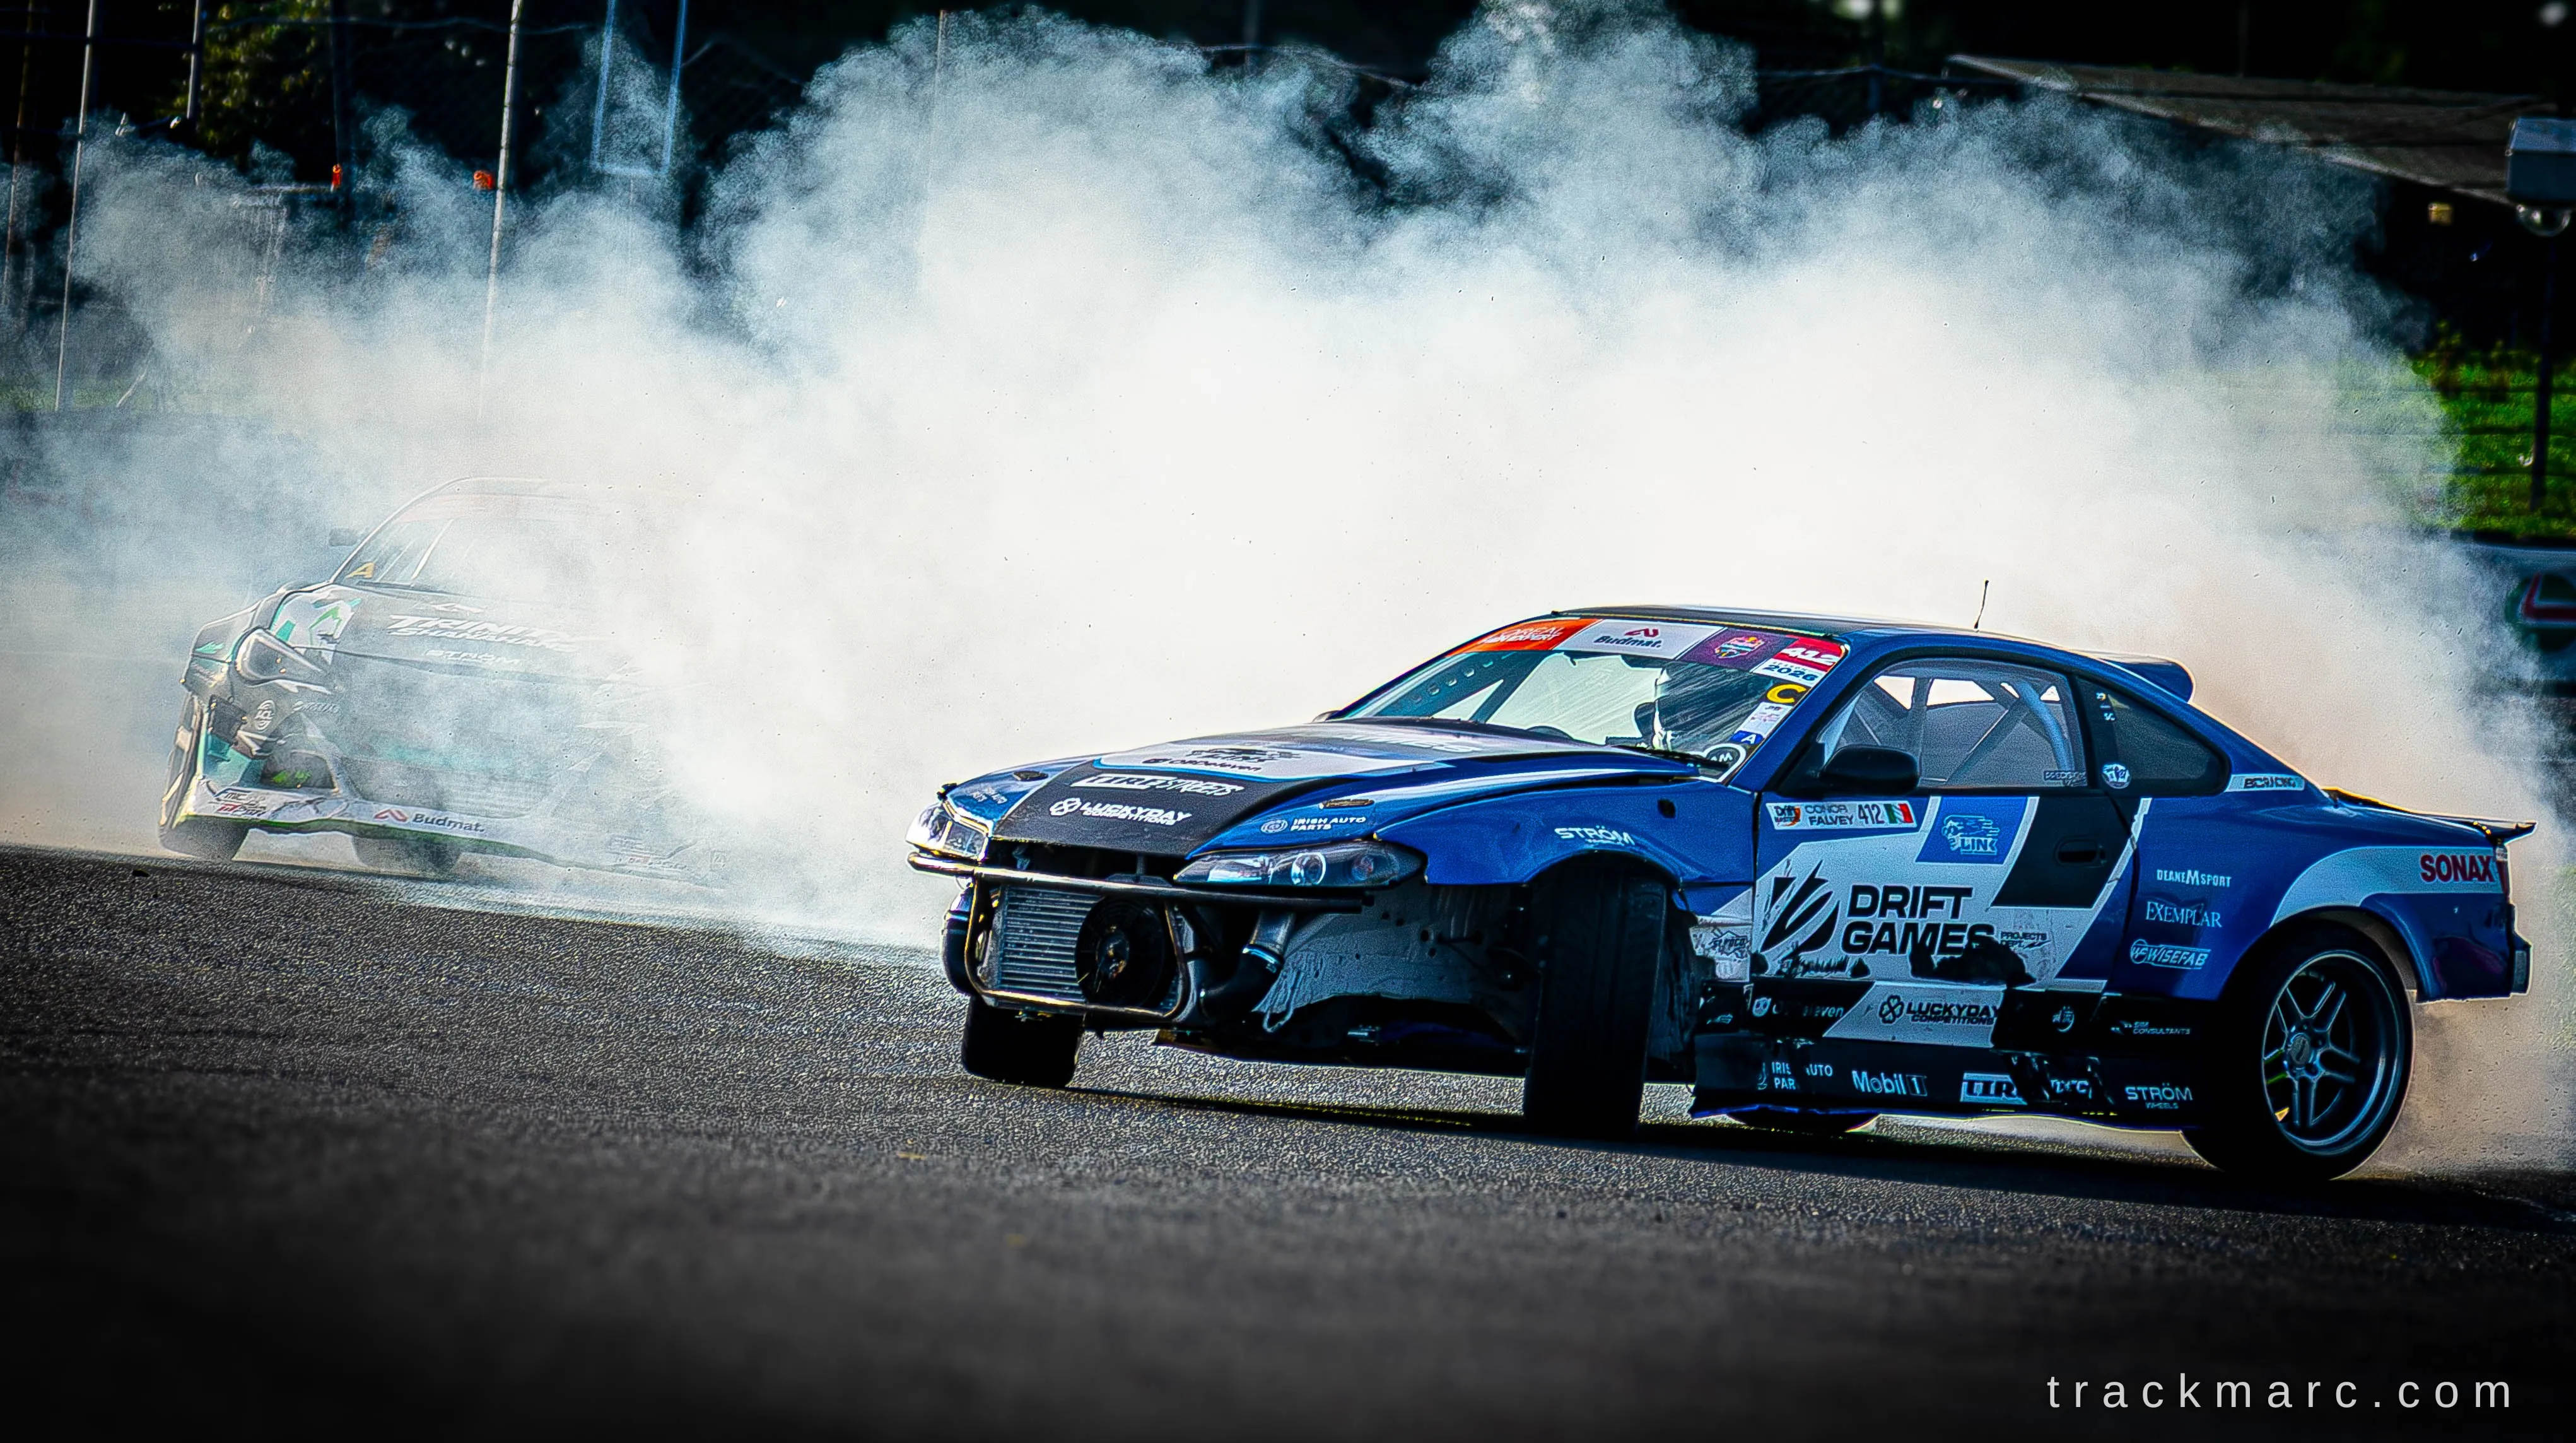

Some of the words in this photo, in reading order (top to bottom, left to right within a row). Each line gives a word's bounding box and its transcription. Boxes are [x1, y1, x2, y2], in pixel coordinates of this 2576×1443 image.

[1781, 647, 1841, 666] 412
[1762, 664, 1819, 681] 2026
[1767, 683, 1807, 704] C
[1741, 734, 1757, 745] A
[1080, 802, 1192, 822] LUCKYDAY
[1293, 818, 1328, 826] IRISH
[1808, 815, 1854, 825] FALVEY
[1858, 804, 1885, 825] 412
[1290, 823, 1332, 832] PARTS
[1554, 825, 1636, 845] STRÖM
[2420, 854, 2495, 882] SONAX
[1847, 884, 1974, 919] DRIFT
[2146, 901, 2223, 928] EXEMPLAR
[2146, 946, 2208, 966] WISEFAB
[1774, 1077, 1796, 1090] PAR
[1851, 1070, 1907, 1095] Mobil
[2124, 1082, 2193, 1100] STRÖM
